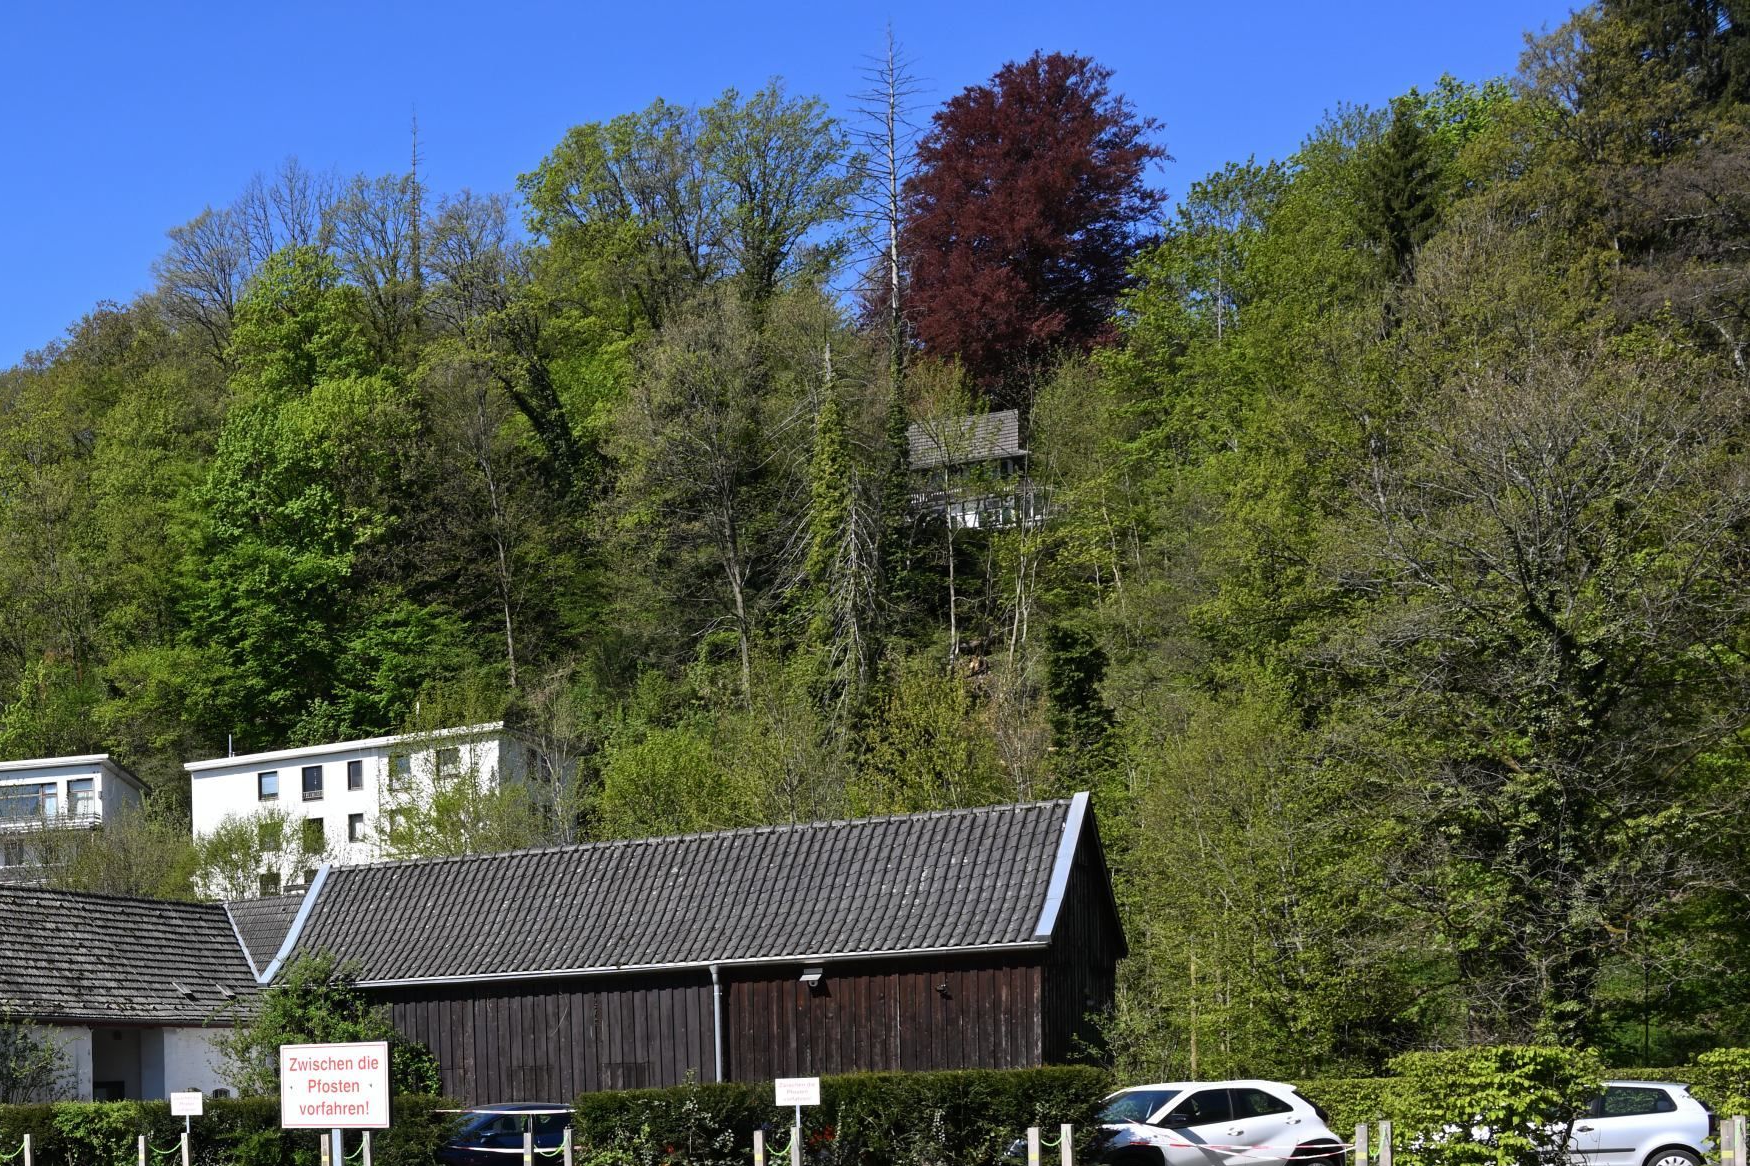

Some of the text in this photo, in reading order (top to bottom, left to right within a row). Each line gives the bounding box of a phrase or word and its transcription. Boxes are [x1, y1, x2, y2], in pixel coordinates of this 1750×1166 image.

[289, 1055, 379, 1072] Zwischen die
[307, 1078, 360, 1093] Pfosten
[299, 1100, 370, 1116] vorfahren!
